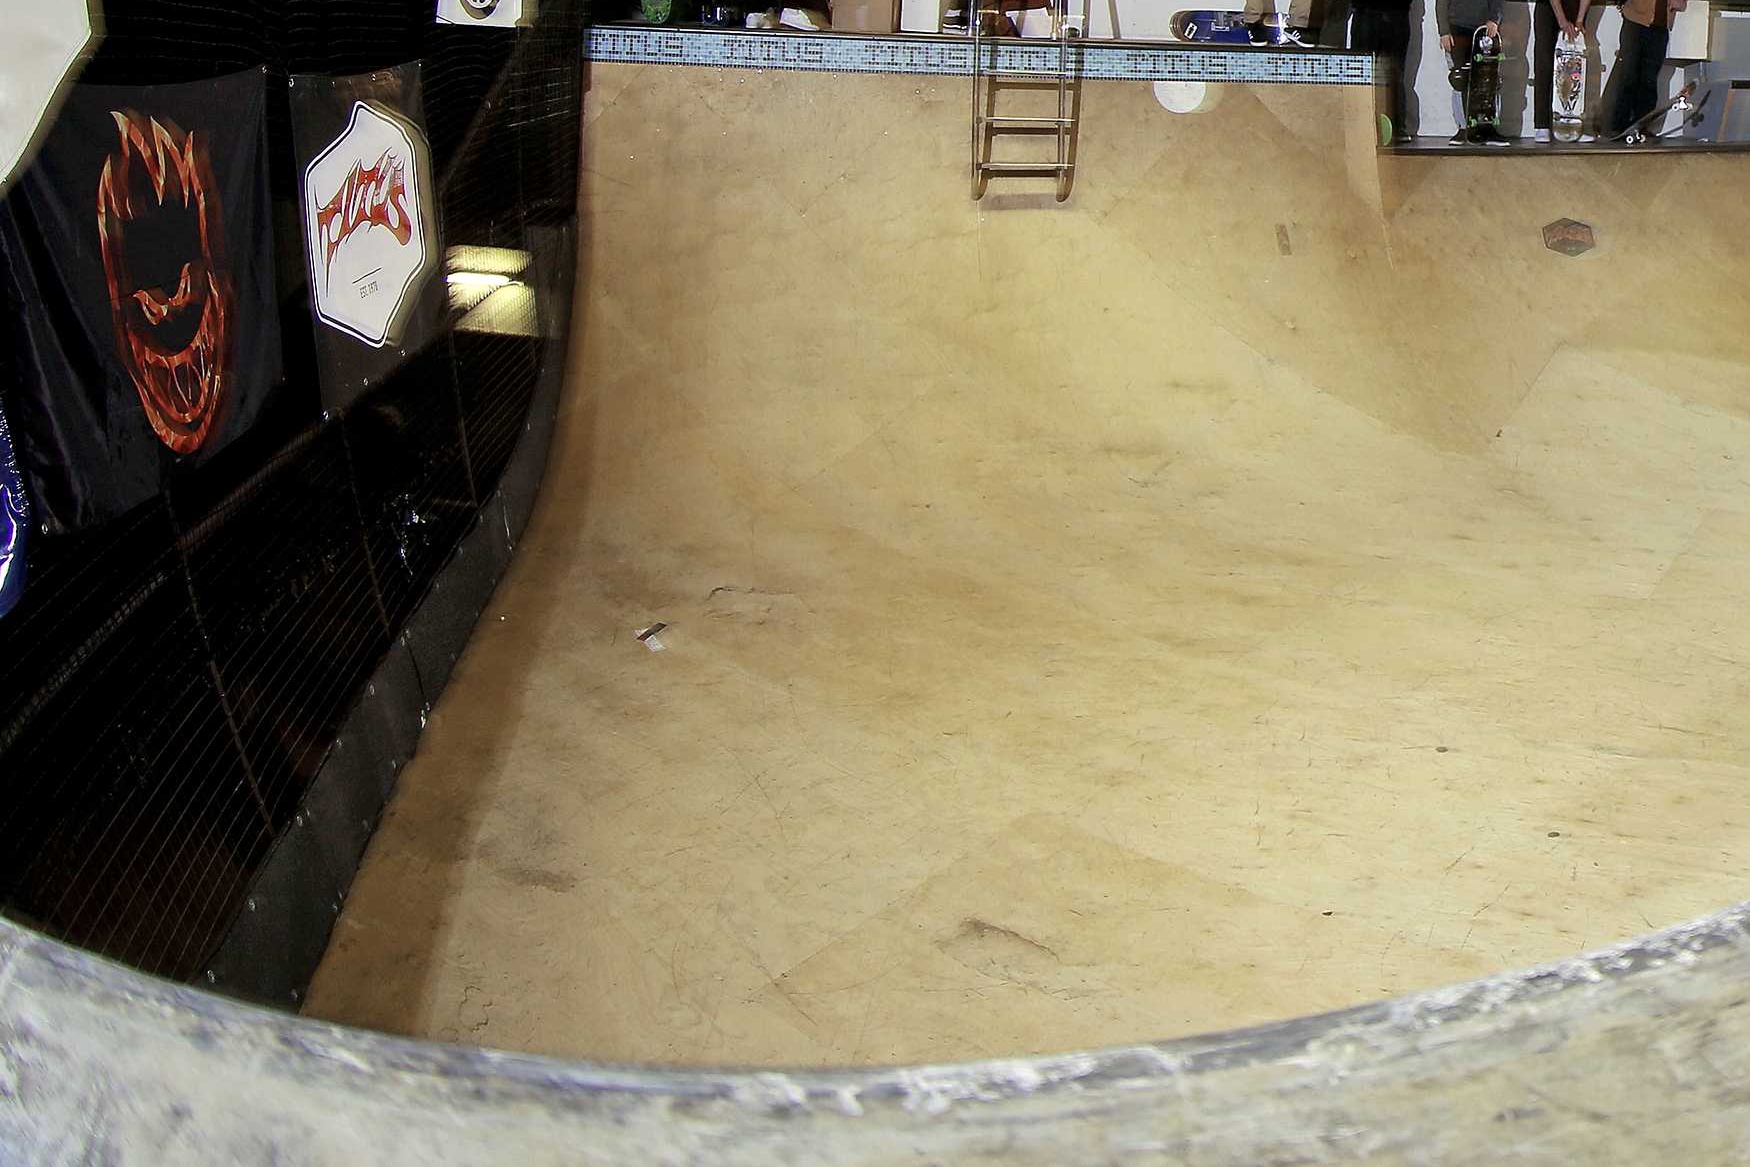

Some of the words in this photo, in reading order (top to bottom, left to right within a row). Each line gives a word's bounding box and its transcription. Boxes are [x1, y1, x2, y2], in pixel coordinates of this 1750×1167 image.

[591, 33, 683, 57] TITUS
[723, 39, 823, 63] TITUS
[864, 44, 967, 68] TITUS
[1126, 53, 1227, 75] TITUS
[1267, 57, 1363, 78] TITUS
